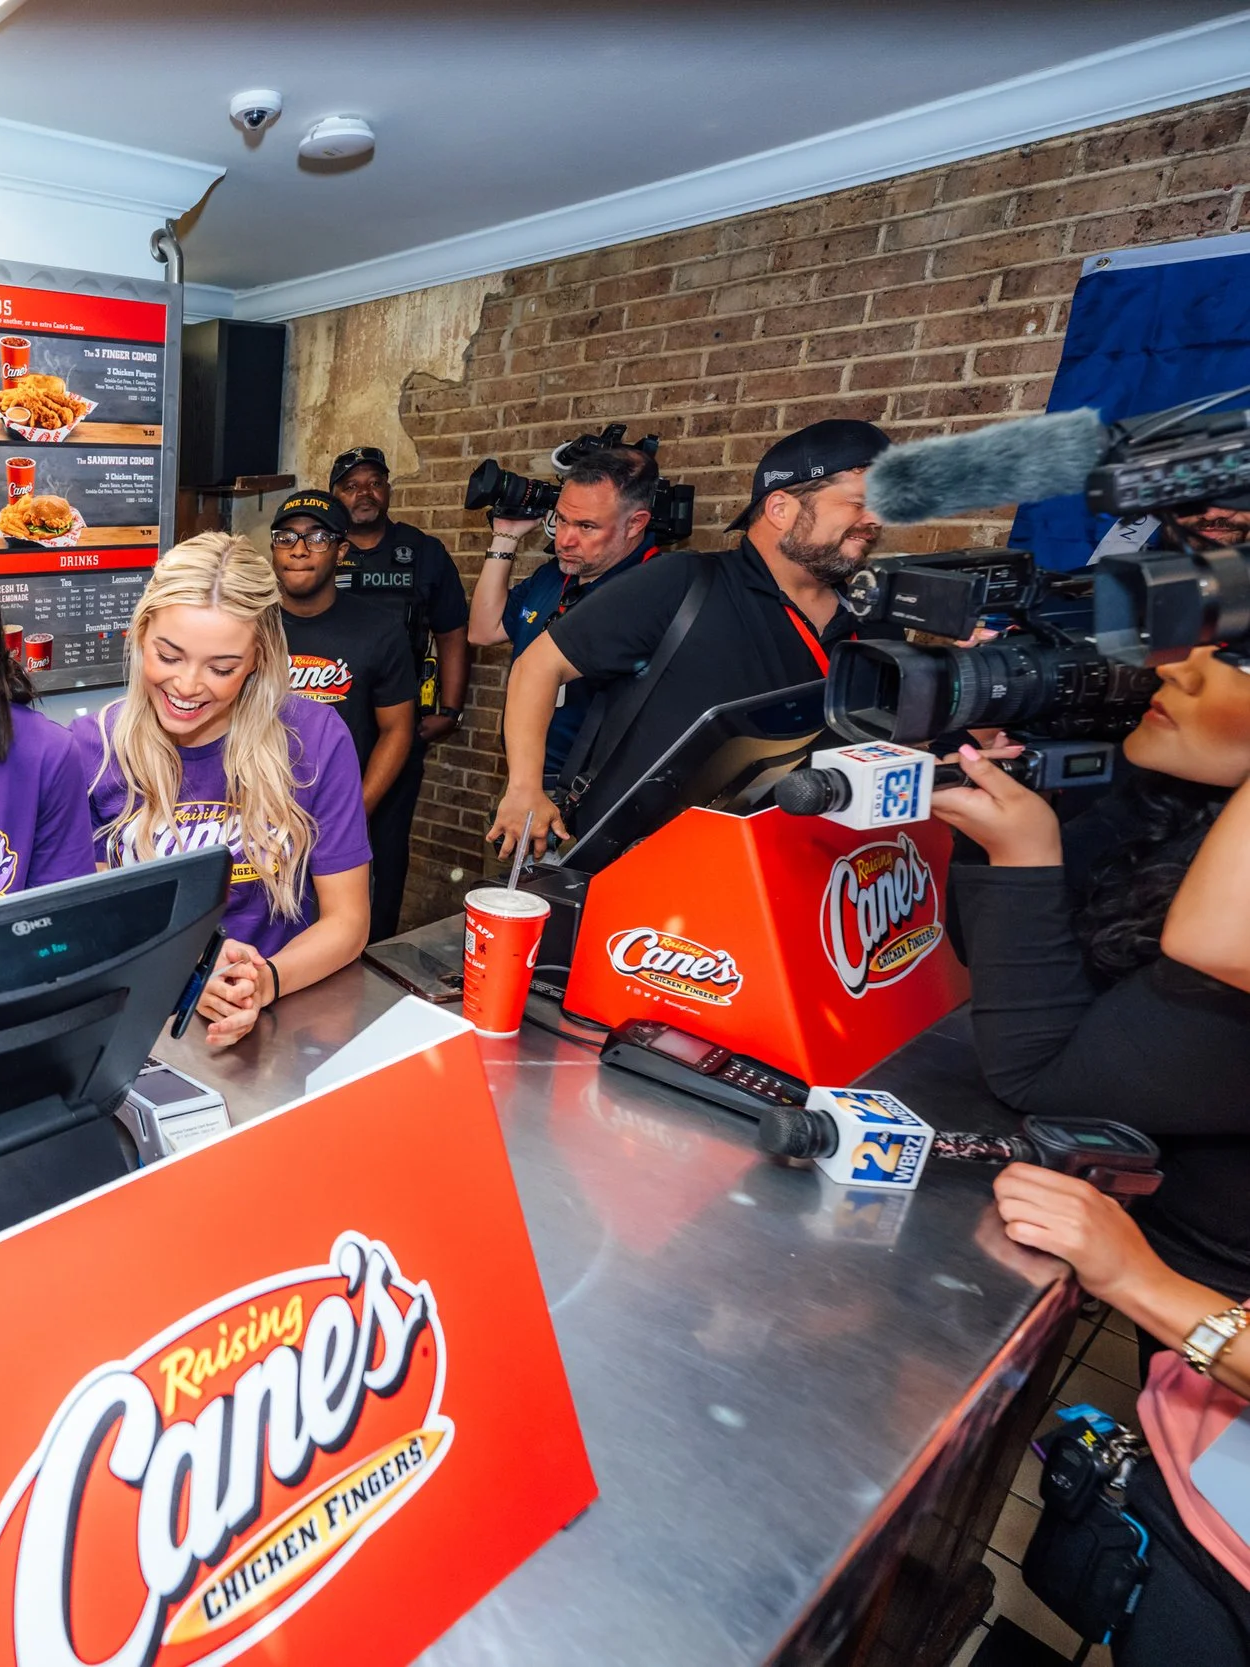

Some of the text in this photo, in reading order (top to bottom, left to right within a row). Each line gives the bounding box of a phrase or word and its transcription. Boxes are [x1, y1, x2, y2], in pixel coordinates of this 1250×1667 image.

[53, 321, 69, 330] Cane's
[84, 348, 158, 362] The 3 FINGER COMBO
[107, 367, 157, 379] 3 Chicken Fingers
[76, 455, 154, 465] The SANDWICH COMBO
[133, 473, 154, 482] Fingers
[283, 498, 330, 511] ONE LOVE
[60, 554, 99, 567] DRINKS
[60, 578, 72, 587] Tea
[112, 574, 143, 584] Lemonade
[362, 573, 411, 586] POLICE
[16, 583, 29, 592] TEA
[0, 593, 29, 603] LEMONADE
[85, 624, 111, 632] Fountain
[294, 656, 327, 669] Raising
[288, 655, 354, 689] ane's
[874, 775, 884, 818] LOCAL
[882, 768, 912, 819] 33
[174, 808, 227, 823] Raising
[855, 851, 893, 884] Raising
[830, 835, 929, 992] Cane's
[30, 917, 53, 930] NCR
[476, 924, 495, 939] APP
[659, 936, 704, 957] Raising
[877, 928, 935, 969] CHICKEN FINGERS
[612, 929, 741, 986] Cane's
[649, 973, 719, 1002] CHICKEN FINGERS
[835, 1096, 895, 1119] 2
[851, 1141, 903, 1174] 2
[892, 1136, 927, 1182] WBRZ
[159, 1295, 304, 1417] Raising
[14, 1240, 429, 1667] Cane's
[201, 1437, 425, 1623] CHICKEN FINGERS
